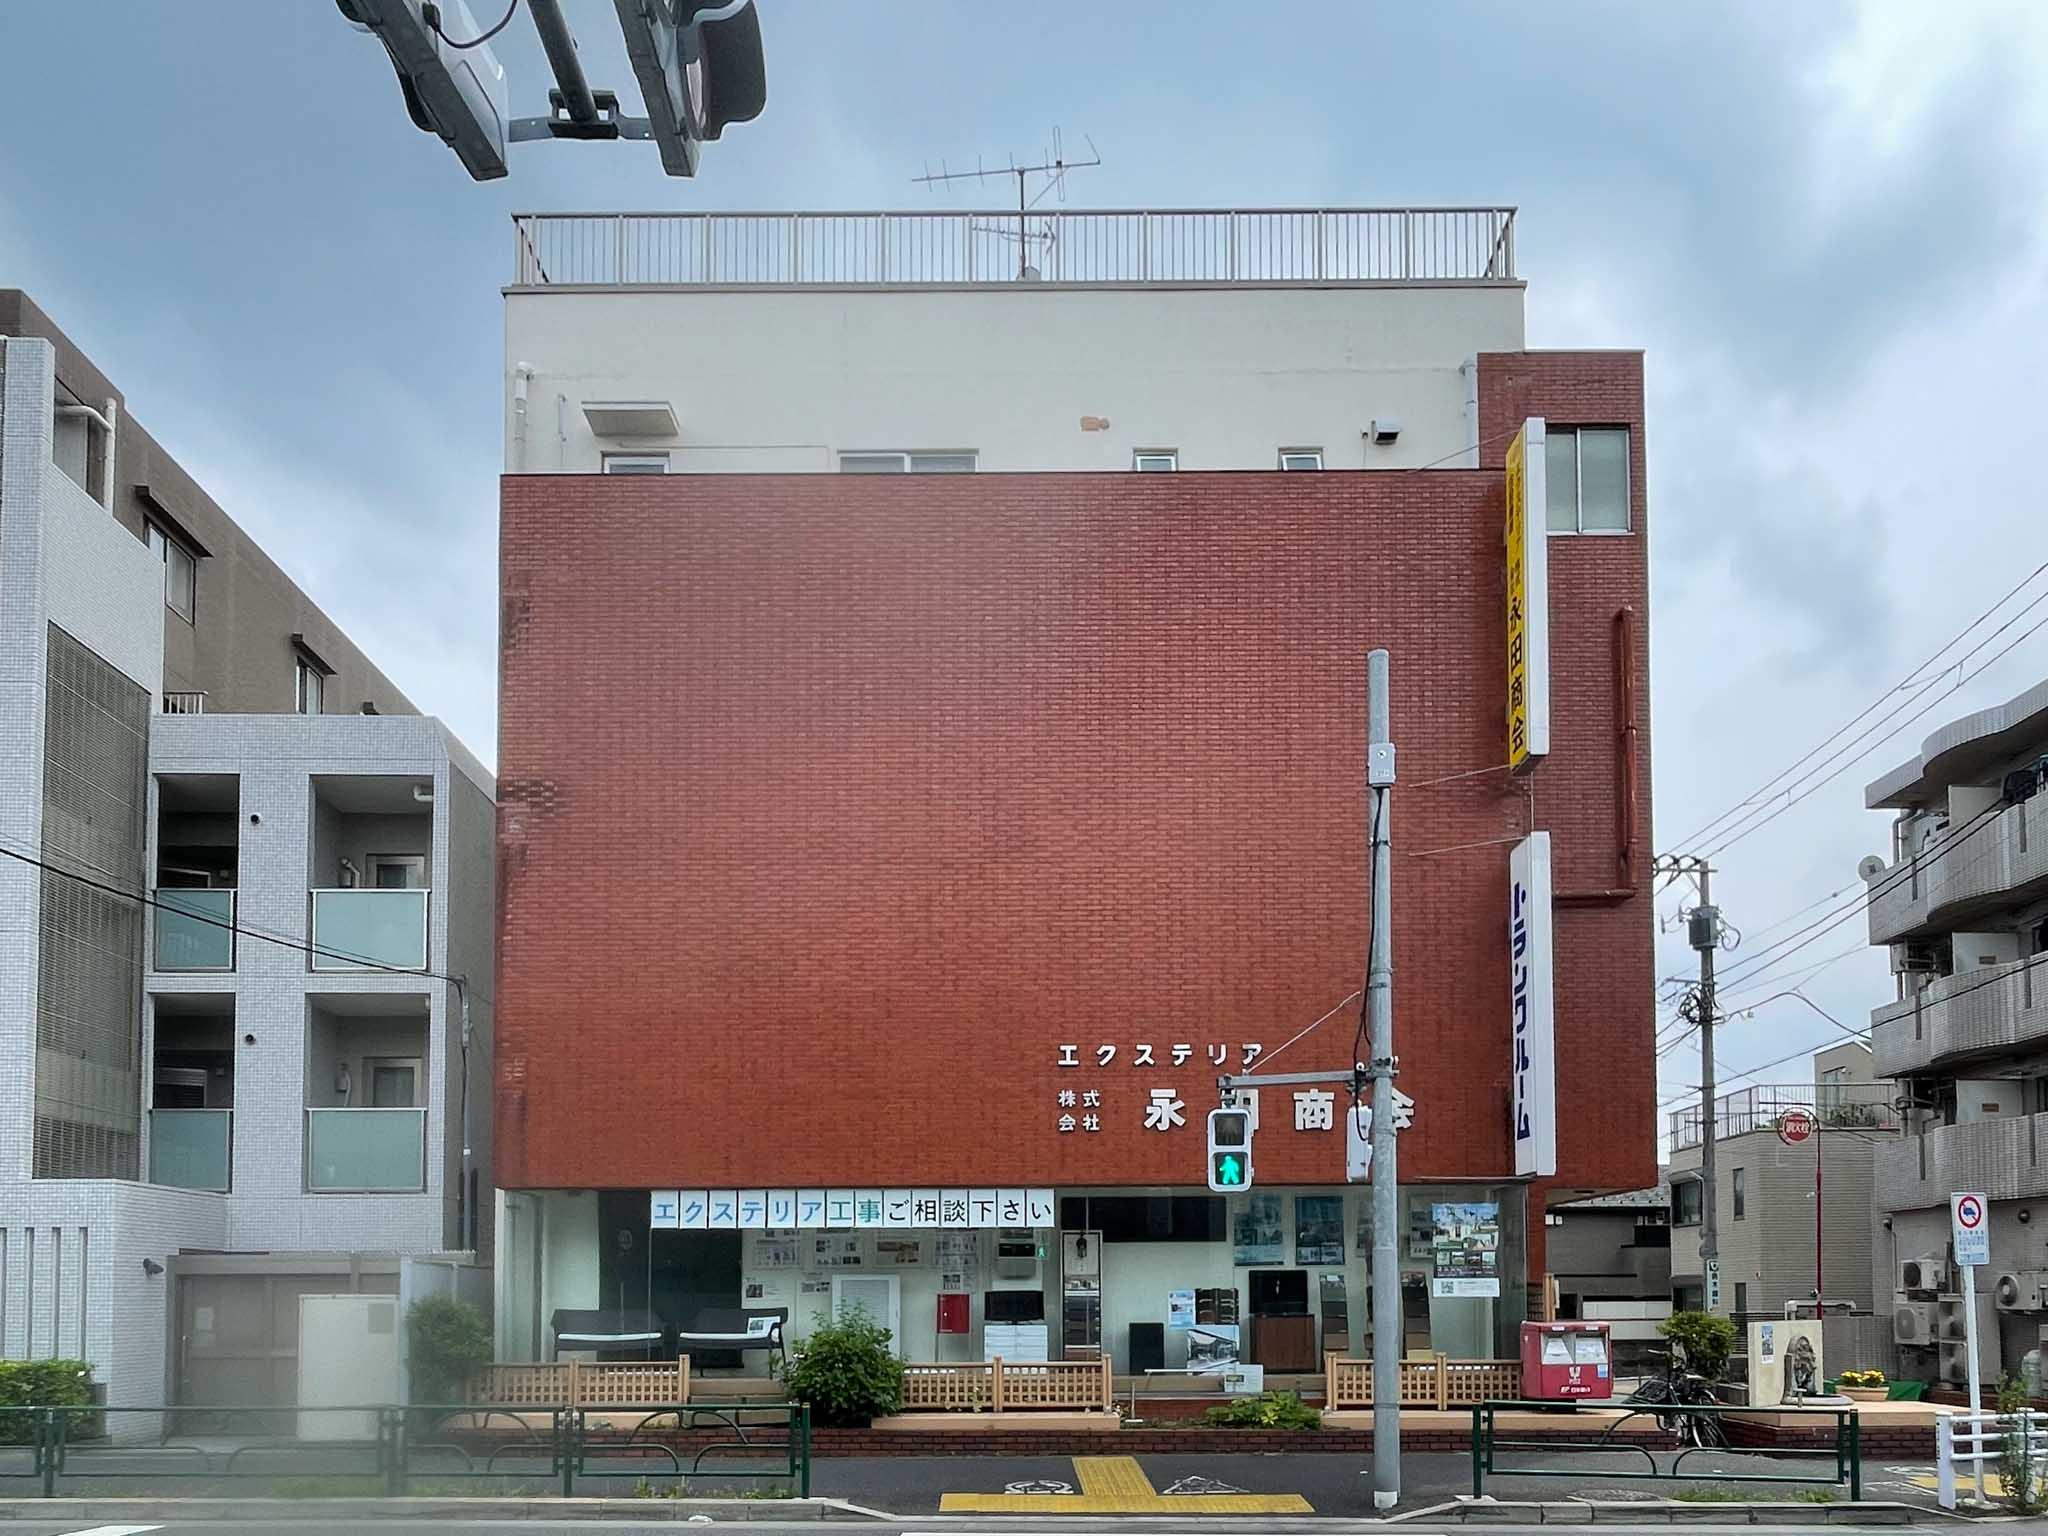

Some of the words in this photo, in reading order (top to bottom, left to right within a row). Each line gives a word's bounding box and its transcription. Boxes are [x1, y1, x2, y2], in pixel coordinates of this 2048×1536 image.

[1509, 596, 1524, 754] 永田商会
[1513, 881, 1531, 1141] トランクルーム
[1057, 1043, 1263, 1067] エクステリア
[1058, 1089, 1100, 1108] 株式
[1058, 1112, 1100, 1132] 会社
[653, 1198, 1052, 1223] エクステリア工事ご相談下さい
